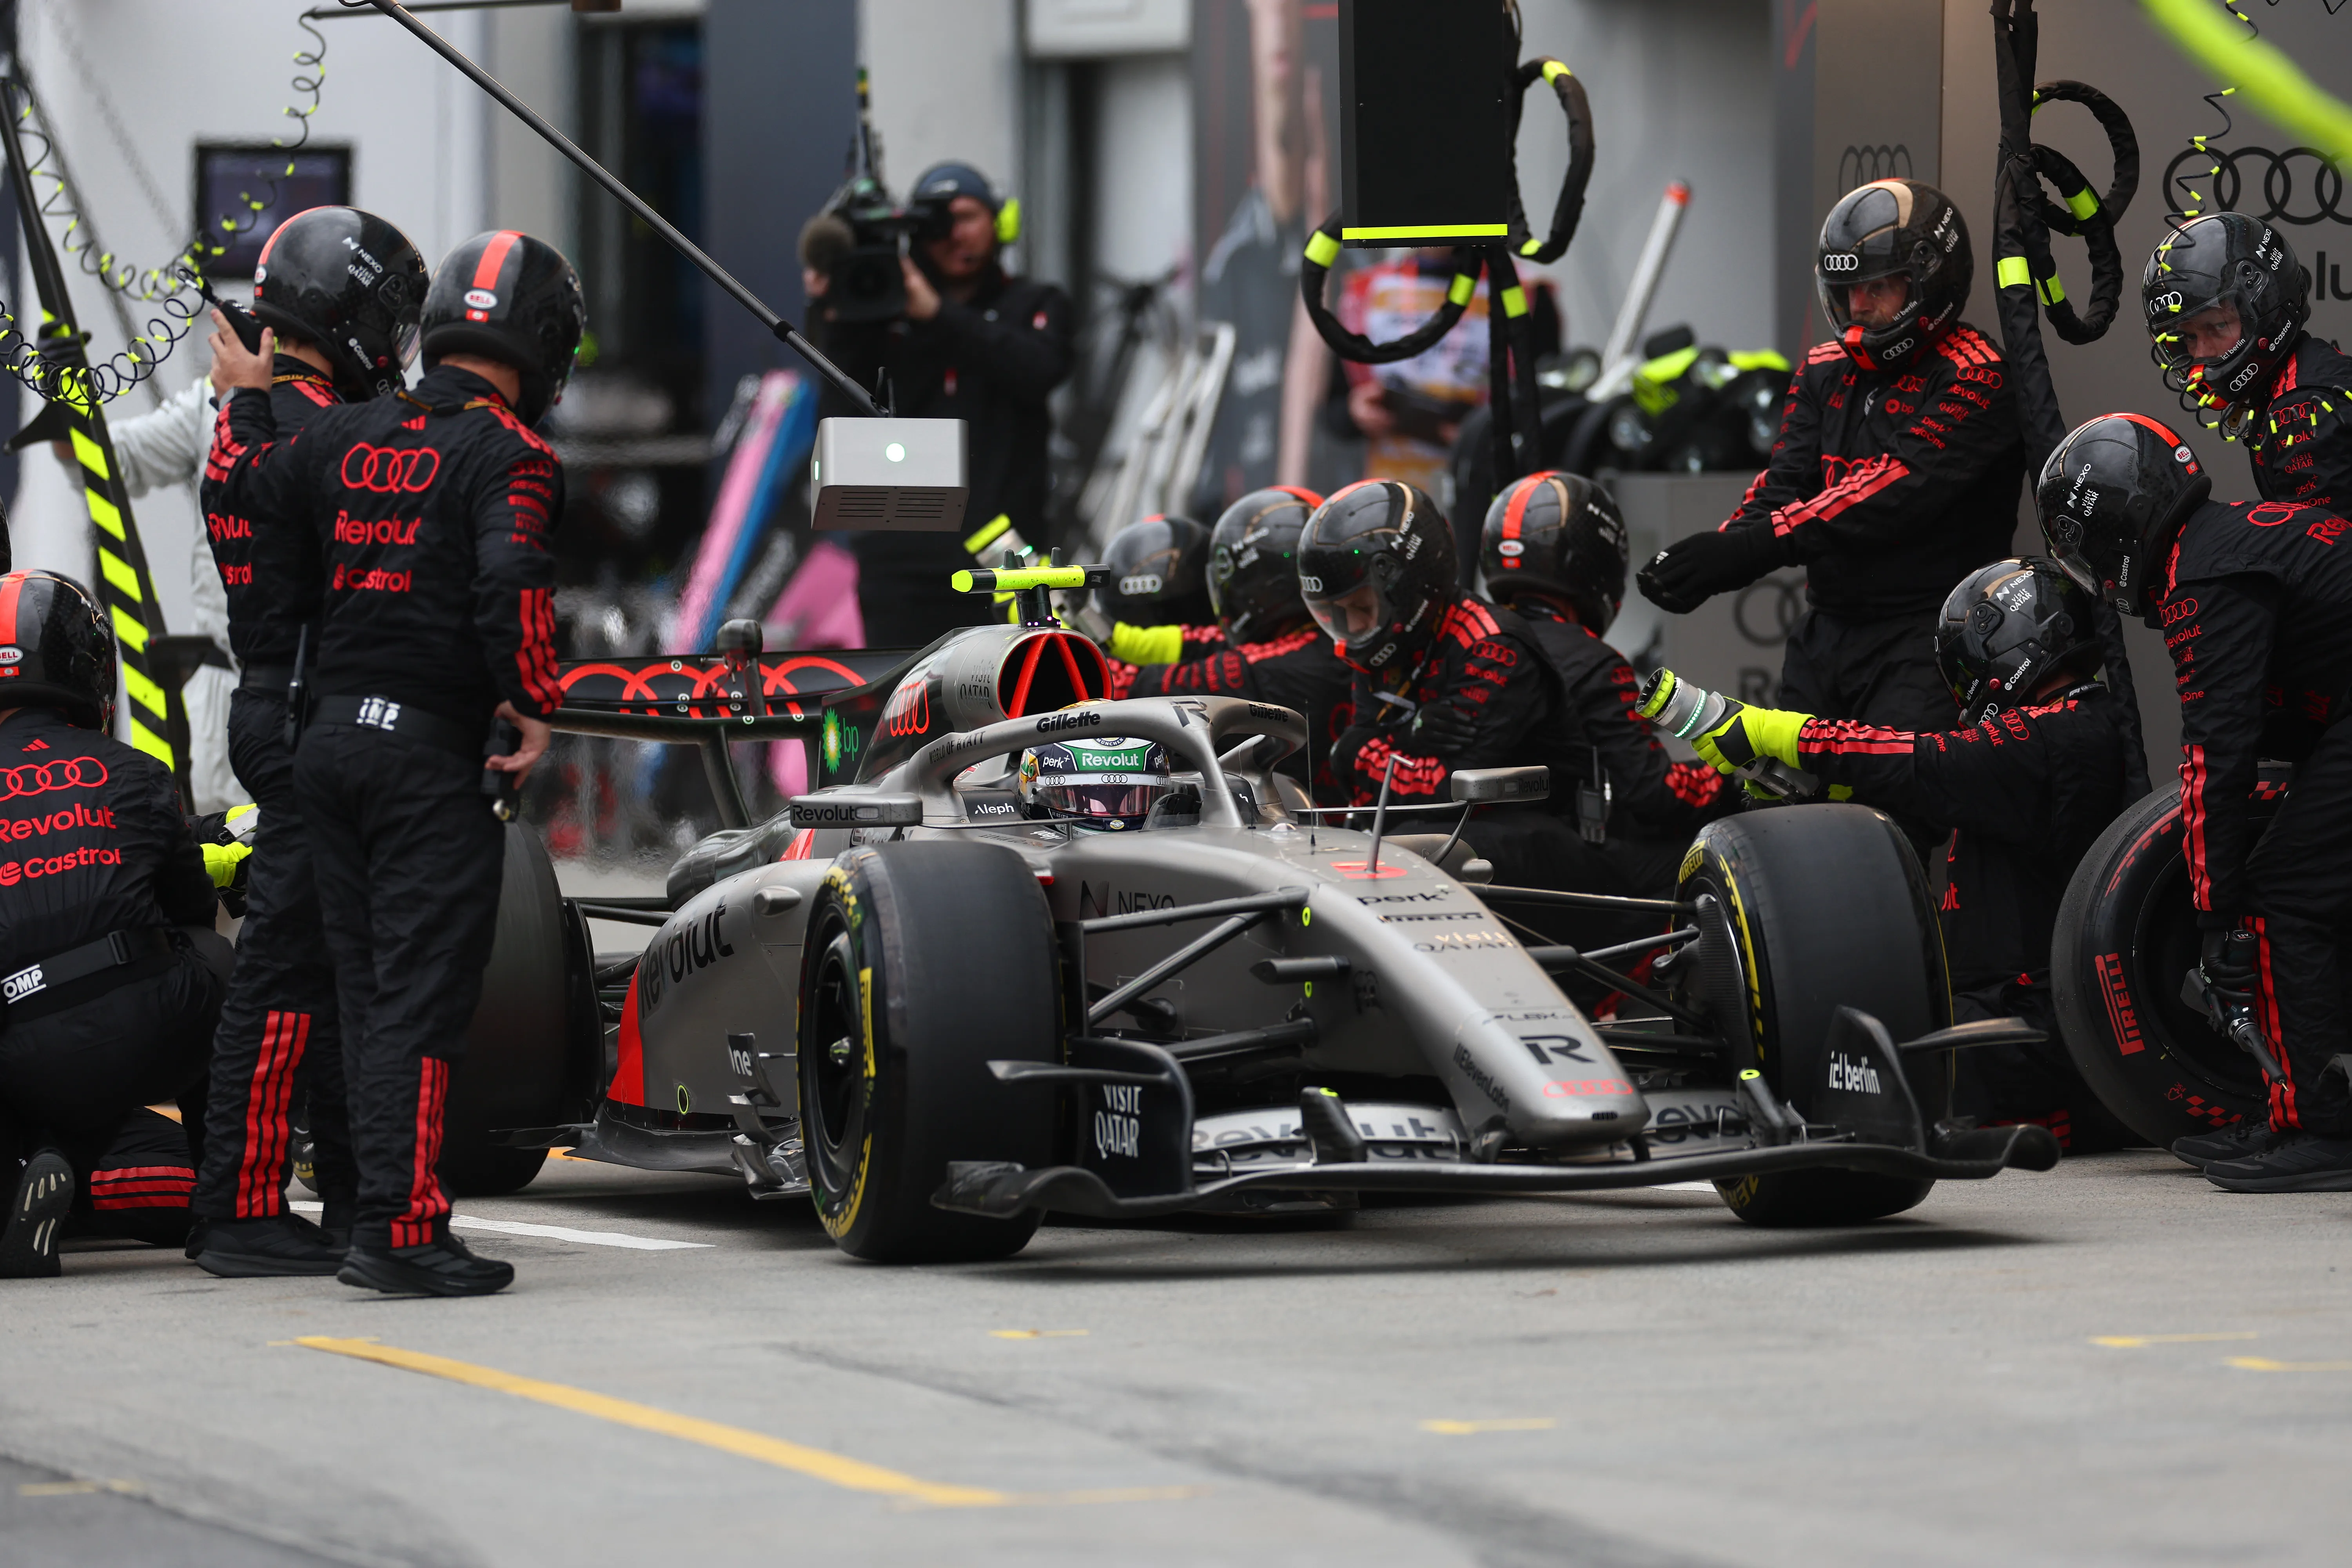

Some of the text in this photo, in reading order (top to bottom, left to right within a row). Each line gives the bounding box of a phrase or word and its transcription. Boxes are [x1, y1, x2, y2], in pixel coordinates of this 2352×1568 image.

[1941, 207, 1953, 227] NEXO
[2261, 229, 2272, 246] NEXO
[358, 248, 383, 273] NEXO
[2270, 247, 2279, 261] visit
[2270, 251, 2283, 270] QATAR
[1900, 300, 1918, 316] berlin
[1933, 301, 1953, 325] Castrol
[2274, 319, 2292, 345] Castrol
[354, 345, 374, 370] Castrol
[2220, 338, 2246, 360] ic! berlin
[1901, 402, 1915, 415] bp
[2177, 448, 2190, 460] BELL
[2290, 452, 2313, 464] visit
[2073, 463, 2091, 492] NEXO
[2285, 459, 2314, 474] QATAR
[2082, 489, 2094, 506] visit
[2083, 493, 2099, 517] QATAR
[1399, 510, 1415, 535] NEXO
[2009, 570, 2034, 588] NEXO
[2120, 555, 2130, 581] Castrol
[2009, 592, 2033, 612] QATAR
[2011, 588, 2028, 603] visit
[971, 659, 994, 684] visit
[2009, 658, 2031, 684] Castrol
[960, 683, 992, 709] QATAR
[1968, 679, 1979, 695] berlin
[1036, 712, 1101, 733] Gillette
[1249, 702, 1289, 722] Gillette
[843, 718, 859, 761] bp
[929, 731, 985, 764] WORLD OF HYATT
[1096, 737, 1124, 746] MÜNCHEN
[1082, 752, 1140, 767] Revolut
[793, 805, 856, 821] Revolut
[975, 803, 1015, 815] Aleph
[0, 803, 117, 843] Revolut
[24, 846, 122, 878] Castrol
[1330, 860, 1408, 879] 5
[1377, 912, 1484, 923] PIRELLI
[639, 895, 735, 1019] Revolut
[3, 968, 43, 998] OMP
[2095, 953, 2146, 1056] PIRELLI
[1519, 1034, 1597, 1065] R
[1828, 1050, 1881, 1094] ic! berlin
[1104, 1083, 1142, 1115] VISIT
[1095, 1110, 1140, 1160] QATAR
